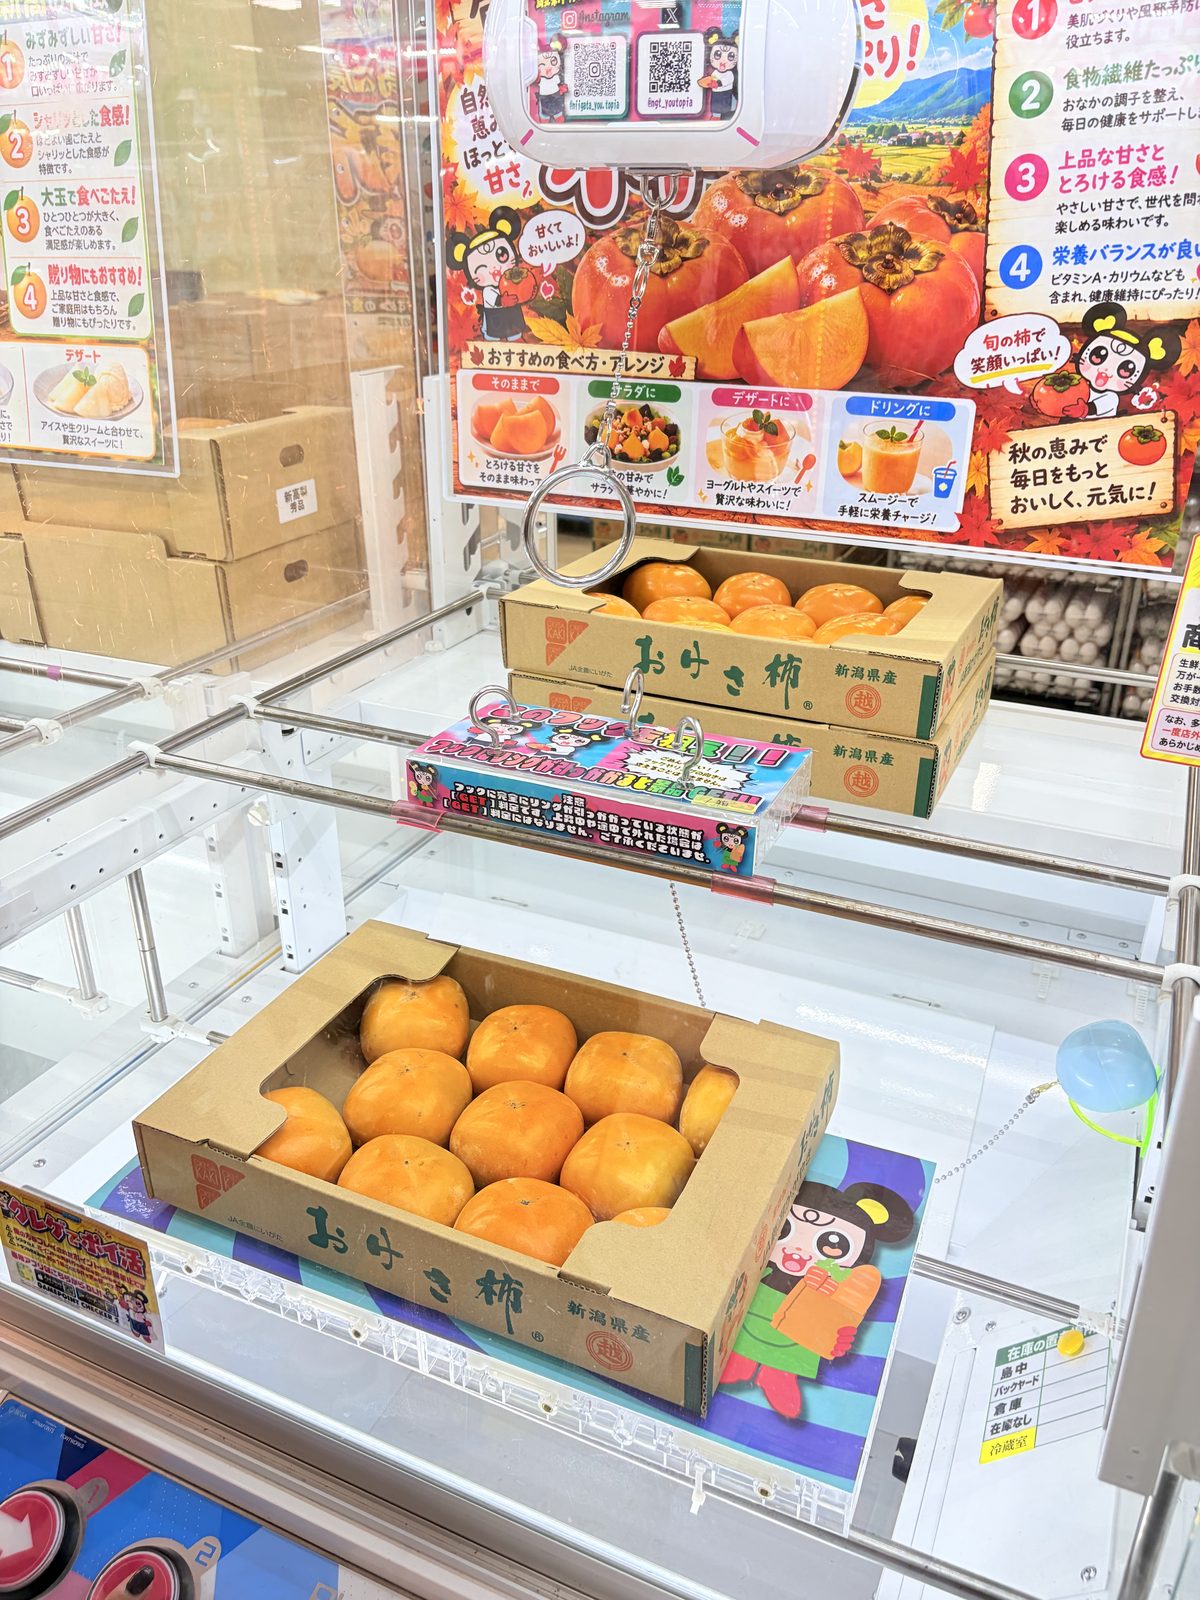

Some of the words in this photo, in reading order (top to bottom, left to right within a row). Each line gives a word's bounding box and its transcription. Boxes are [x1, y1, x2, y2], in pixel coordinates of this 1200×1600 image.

[1066, 27, 1131, 50] 役立ちます。
[1062, 87, 1185, 112] おなかの調子を整え、
[1060, 106, 1200, 133] 毎日の健康をサポートし
[38, 145, 110, 161] シャリッとした食感が
[464, 140, 517, 170] ほっと
[1058, 143, 1165, 171] 上品な甘さと
[38, 162, 73, 176] 特徴です。
[483, 160, 533, 199] 甘さ!
[1058, 165, 1179, 194] とろける食感!
[41, 185, 136, 207] 大玉で食べごたえ!
[43, 210, 120, 223] ひとつひとつが大きく、
[1054, 213, 1170, 235] 楽しめる味わいです。
[44, 225, 103, 237] 食べごたえのある
[535, 221, 562, 239] 甘くて
[45, 239, 117, 251] 満足感が楽しめます。
[528, 234, 579, 257] おいしいよ!
[48, 263, 142, 286] 贈り物にもおすすめ!
[1051, 268, 1186, 287] ビタミンA・カリウムなども
[50, 290, 120, 302] 上品な甘さと食感で、
[52, 303, 117, 316] ご家庭用はもちろん
[53, 316, 136, 331] 贈り物にもぴったりです。
[982, 327, 1046, 352] 旬の柿で
[66, 348, 101, 363] デザート
[488, 347, 665, 374] おすすめの食べ方・アレンジ
[970, 345, 1061, 374] 笑顔いっぱい!
[491, 376, 540, 392] そのままで
[732, 391, 790, 407] デザートに
[40, 420, 144, 439] アイスや生クリームと合わせて、
[62, 435, 123, 449] 贅沢なスイーツに!
[1008, 434, 1109, 465] 秋の恵みで
[486, 459, 540, 474] とろける甘さを
[611, 470, 654, 484] の甘みで
[1010, 461, 1110, 490] 毎日をもっと
[706, 479, 802, 497] ヨーグルトやスイーツで
[1010, 481, 1157, 514] おいしく、元気に!
[715, 492, 791, 511] 贅沢な味わいに!
[858, 492, 920, 508] スムージーで
[837, 504, 937, 526] 手軽に栄養チャージ!
[835, 663, 897, 686] 新潟県産
[1179, 659, 1200, 671] 生鮮
[833, 744, 895, 766] 新潟県産
[37, 1282, 80, 1310] GAMEPOINT
[81, 1301, 113, 1321] CHECKER
[114, 1314, 120, 1324] 2
[567, 1299, 651, 1343] 新潟県産
[994, 1374, 1040, 1398] バックヤード
[990, 1414, 1033, 1436] 在庫なし
[989, 1435, 1028, 1456] 冷蔵室
[195, 1540, 218, 1568] 2
